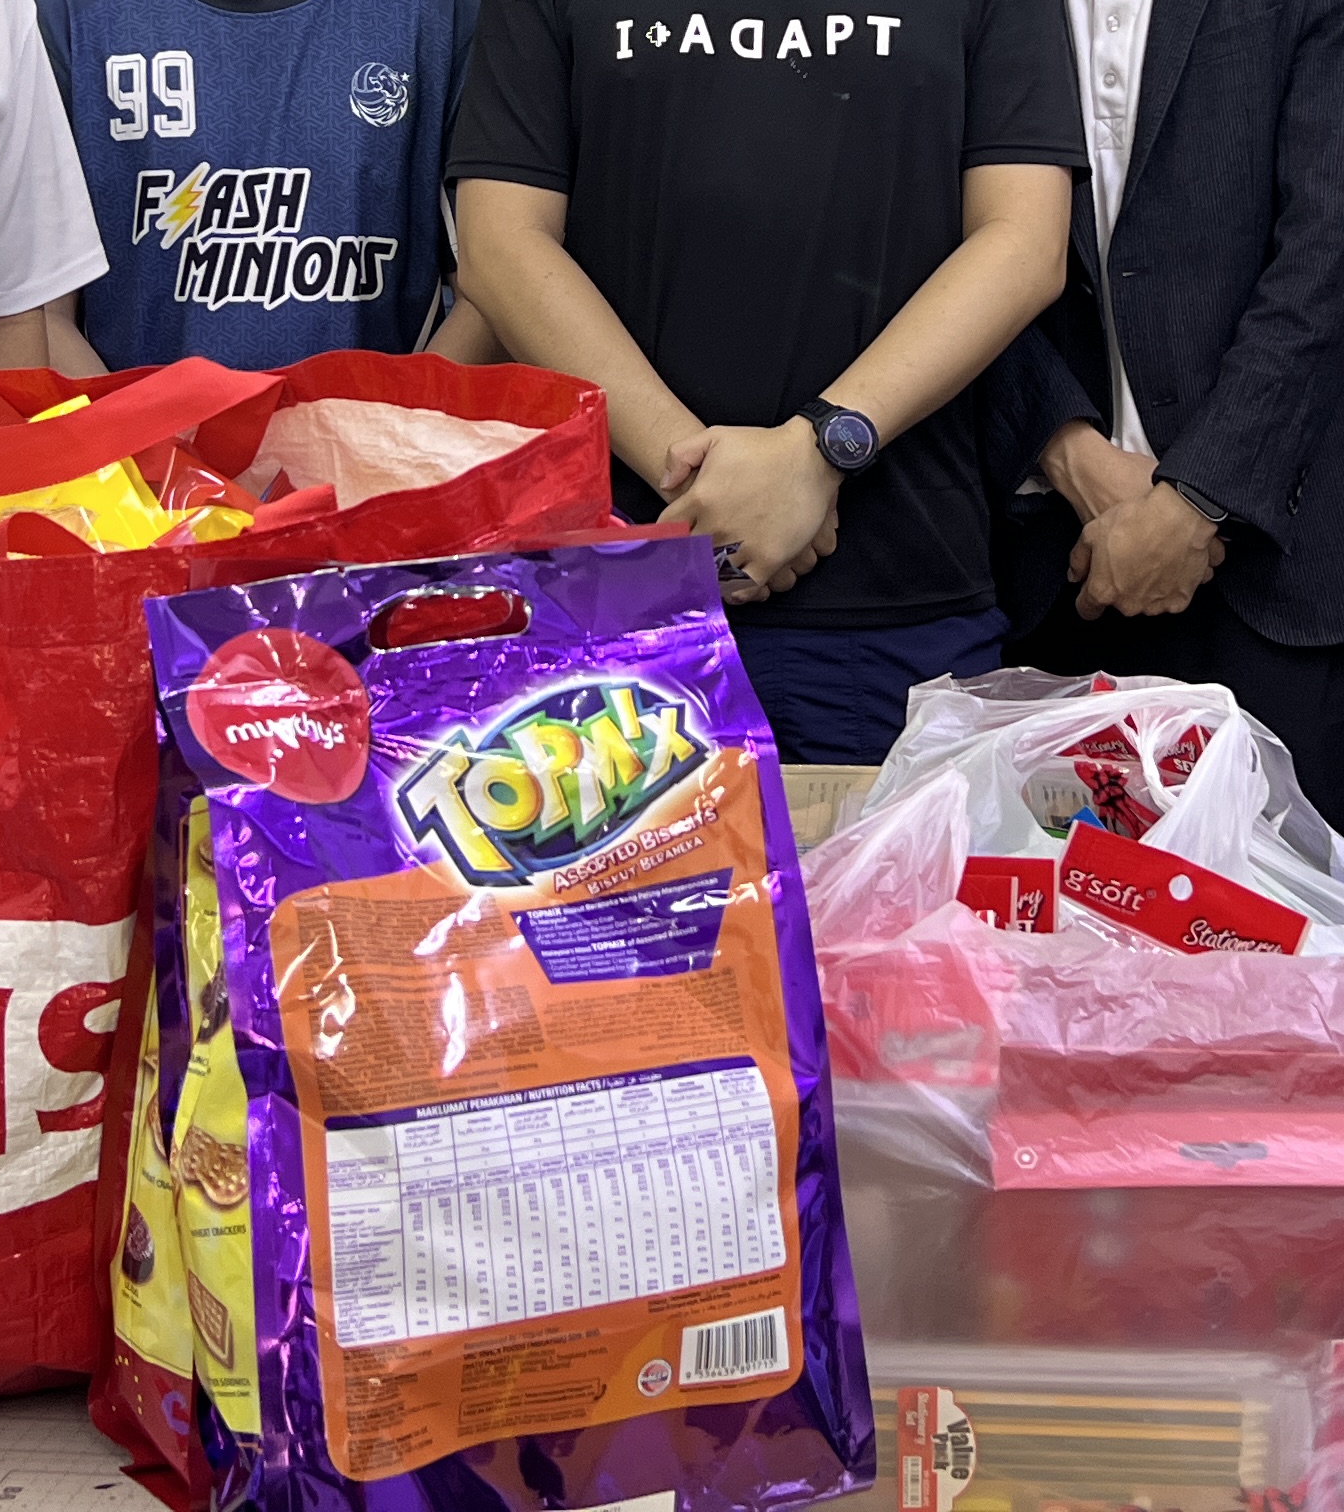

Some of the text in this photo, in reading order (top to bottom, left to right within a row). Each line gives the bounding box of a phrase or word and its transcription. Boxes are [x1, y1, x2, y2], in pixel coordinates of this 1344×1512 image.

[616, 13, 901, 60] I ADAPT
[106, 50, 197, 141] 99
[174, 236, 398, 311] MINIONS
[404, 686, 698, 872] TOPMIX
[553, 840, 641, 893] ASSORTED
[586, 865, 637, 895] BISKUT
[526, 907, 562, 920] TOPMIX
[591, 939, 626, 952] TOPMIX
[416, 1101, 468, 1118] MAKLUMAT
[470, 1092, 523, 1110] PEMAKANAN
[529, 1083, 575, 1101] NUTRITION
[576, 1081, 601, 1095] FACTS
[211, 1223, 247, 1236] CRACKERS
[946, 1418, 974, 1480] Value
